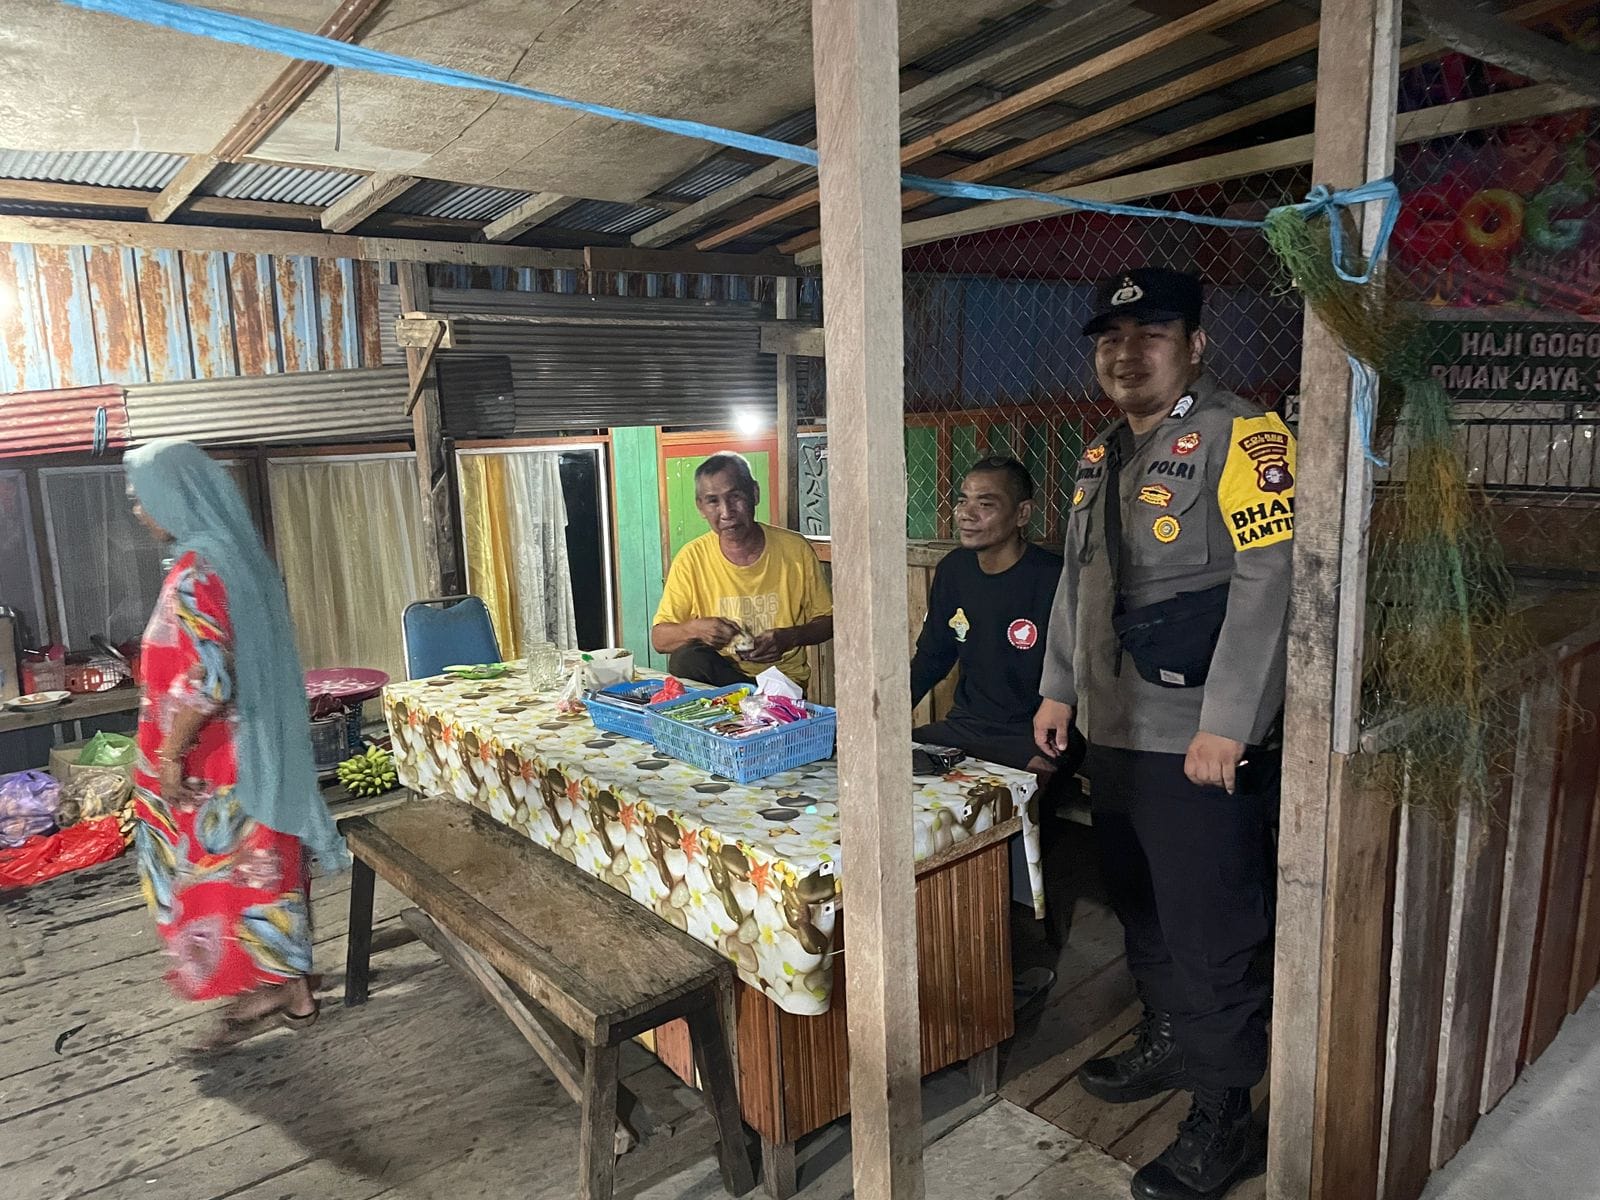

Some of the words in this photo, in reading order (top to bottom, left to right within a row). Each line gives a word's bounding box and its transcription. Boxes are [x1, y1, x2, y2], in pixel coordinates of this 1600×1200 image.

[1461, 332, 1523, 357] HAJI
[1529, 332, 1600, 358] GOGO
[1515, 366, 1587, 394] JAYA,
[1147, 460, 1196, 480] POLRI
